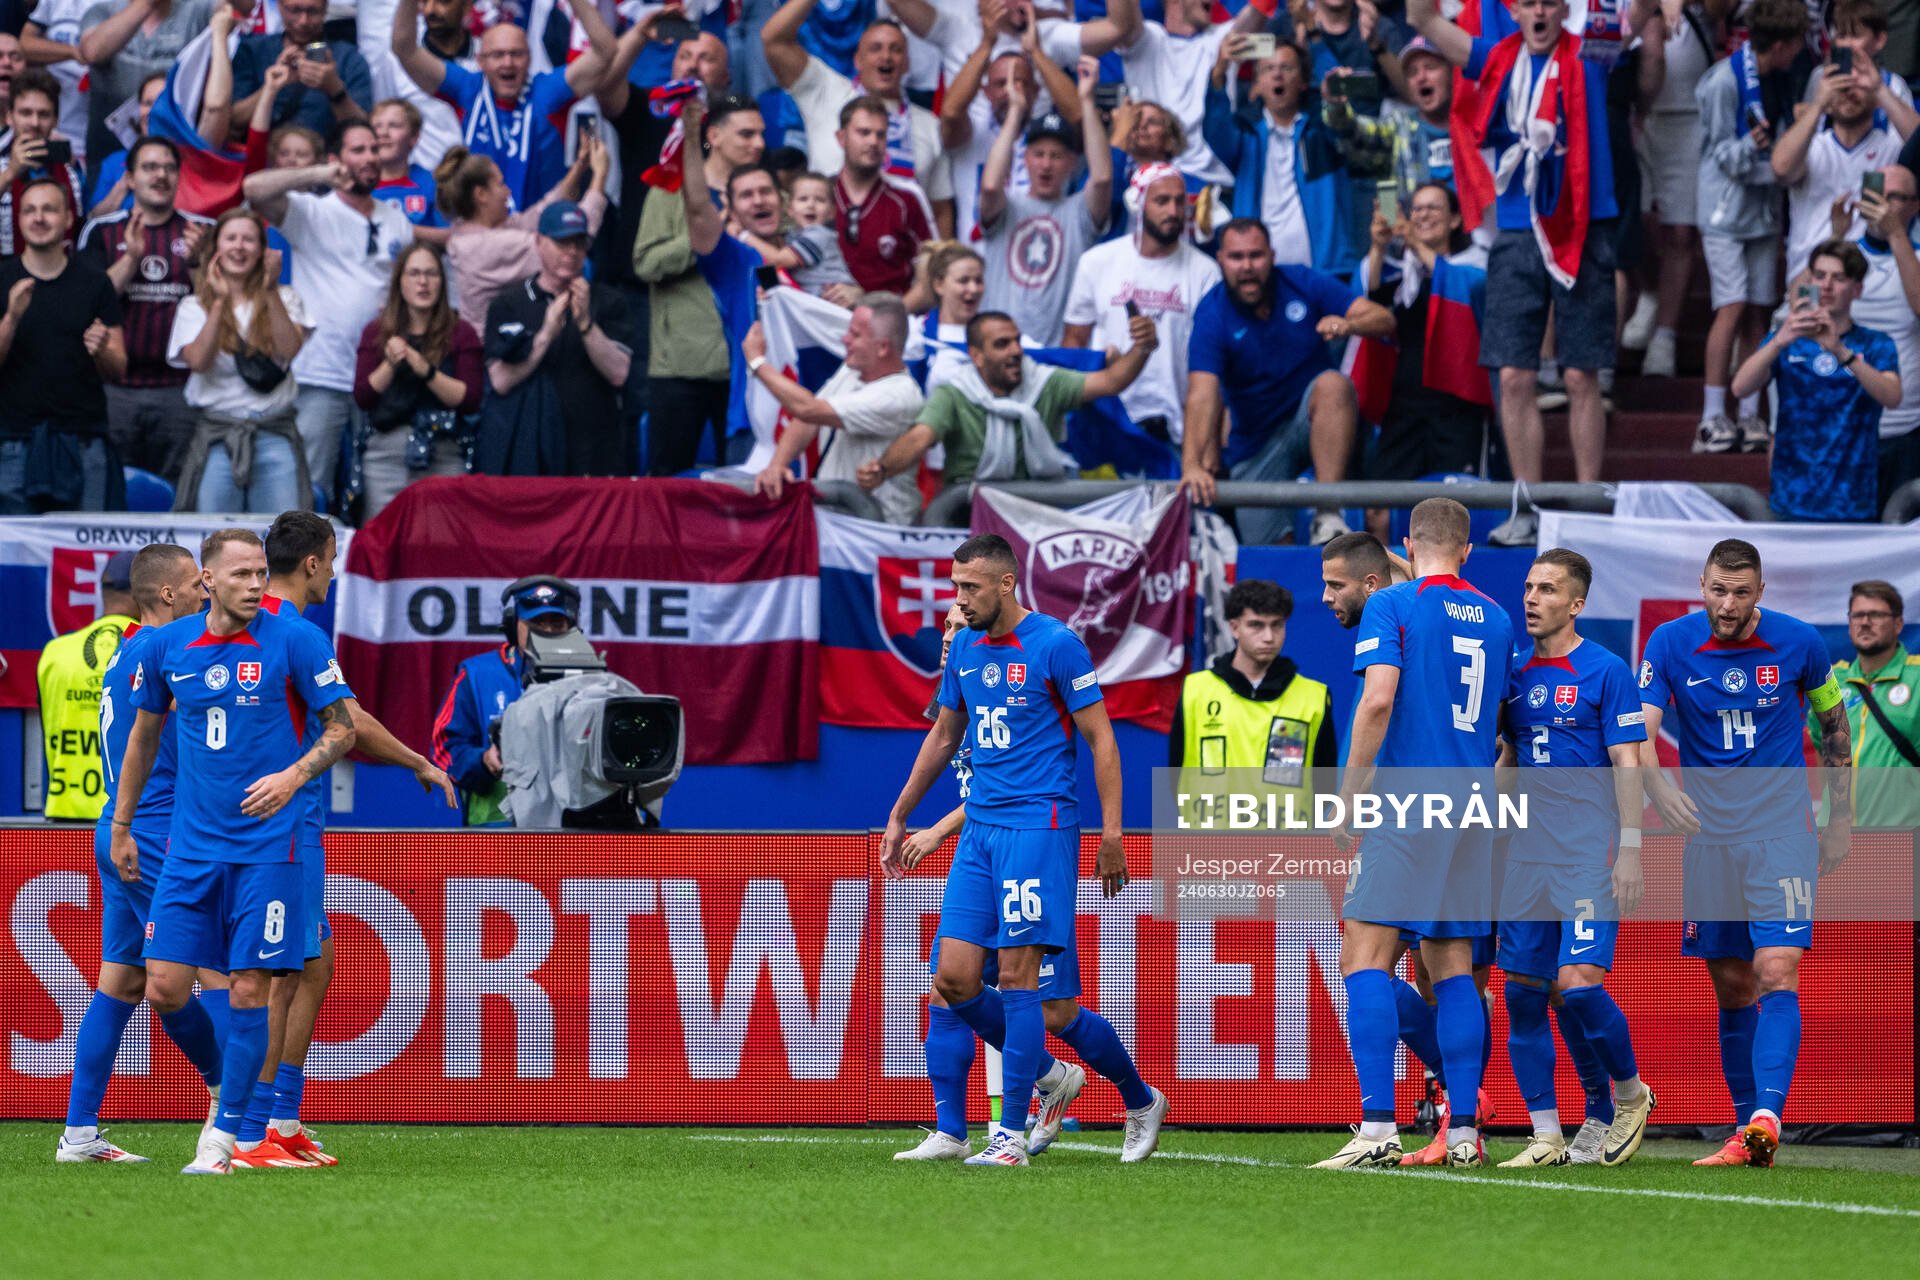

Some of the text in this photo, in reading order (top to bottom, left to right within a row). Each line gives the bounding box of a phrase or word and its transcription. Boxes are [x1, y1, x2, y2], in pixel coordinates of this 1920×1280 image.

[407, 585, 690, 638] OLNE
[1443, 599, 1485, 623] VAVRO
[1451, 634, 1486, 733] 3
[206, 706, 226, 750] 8
[976, 706, 1011, 749] 26
[1530, 725, 1551, 763] 2
[1717, 709, 1757, 750] 14
[1003, 879, 1042, 923] 26
[1779, 877, 1812, 919] 14
[263, 899, 286, 944] 8
[1574, 899, 1595, 941] 2
